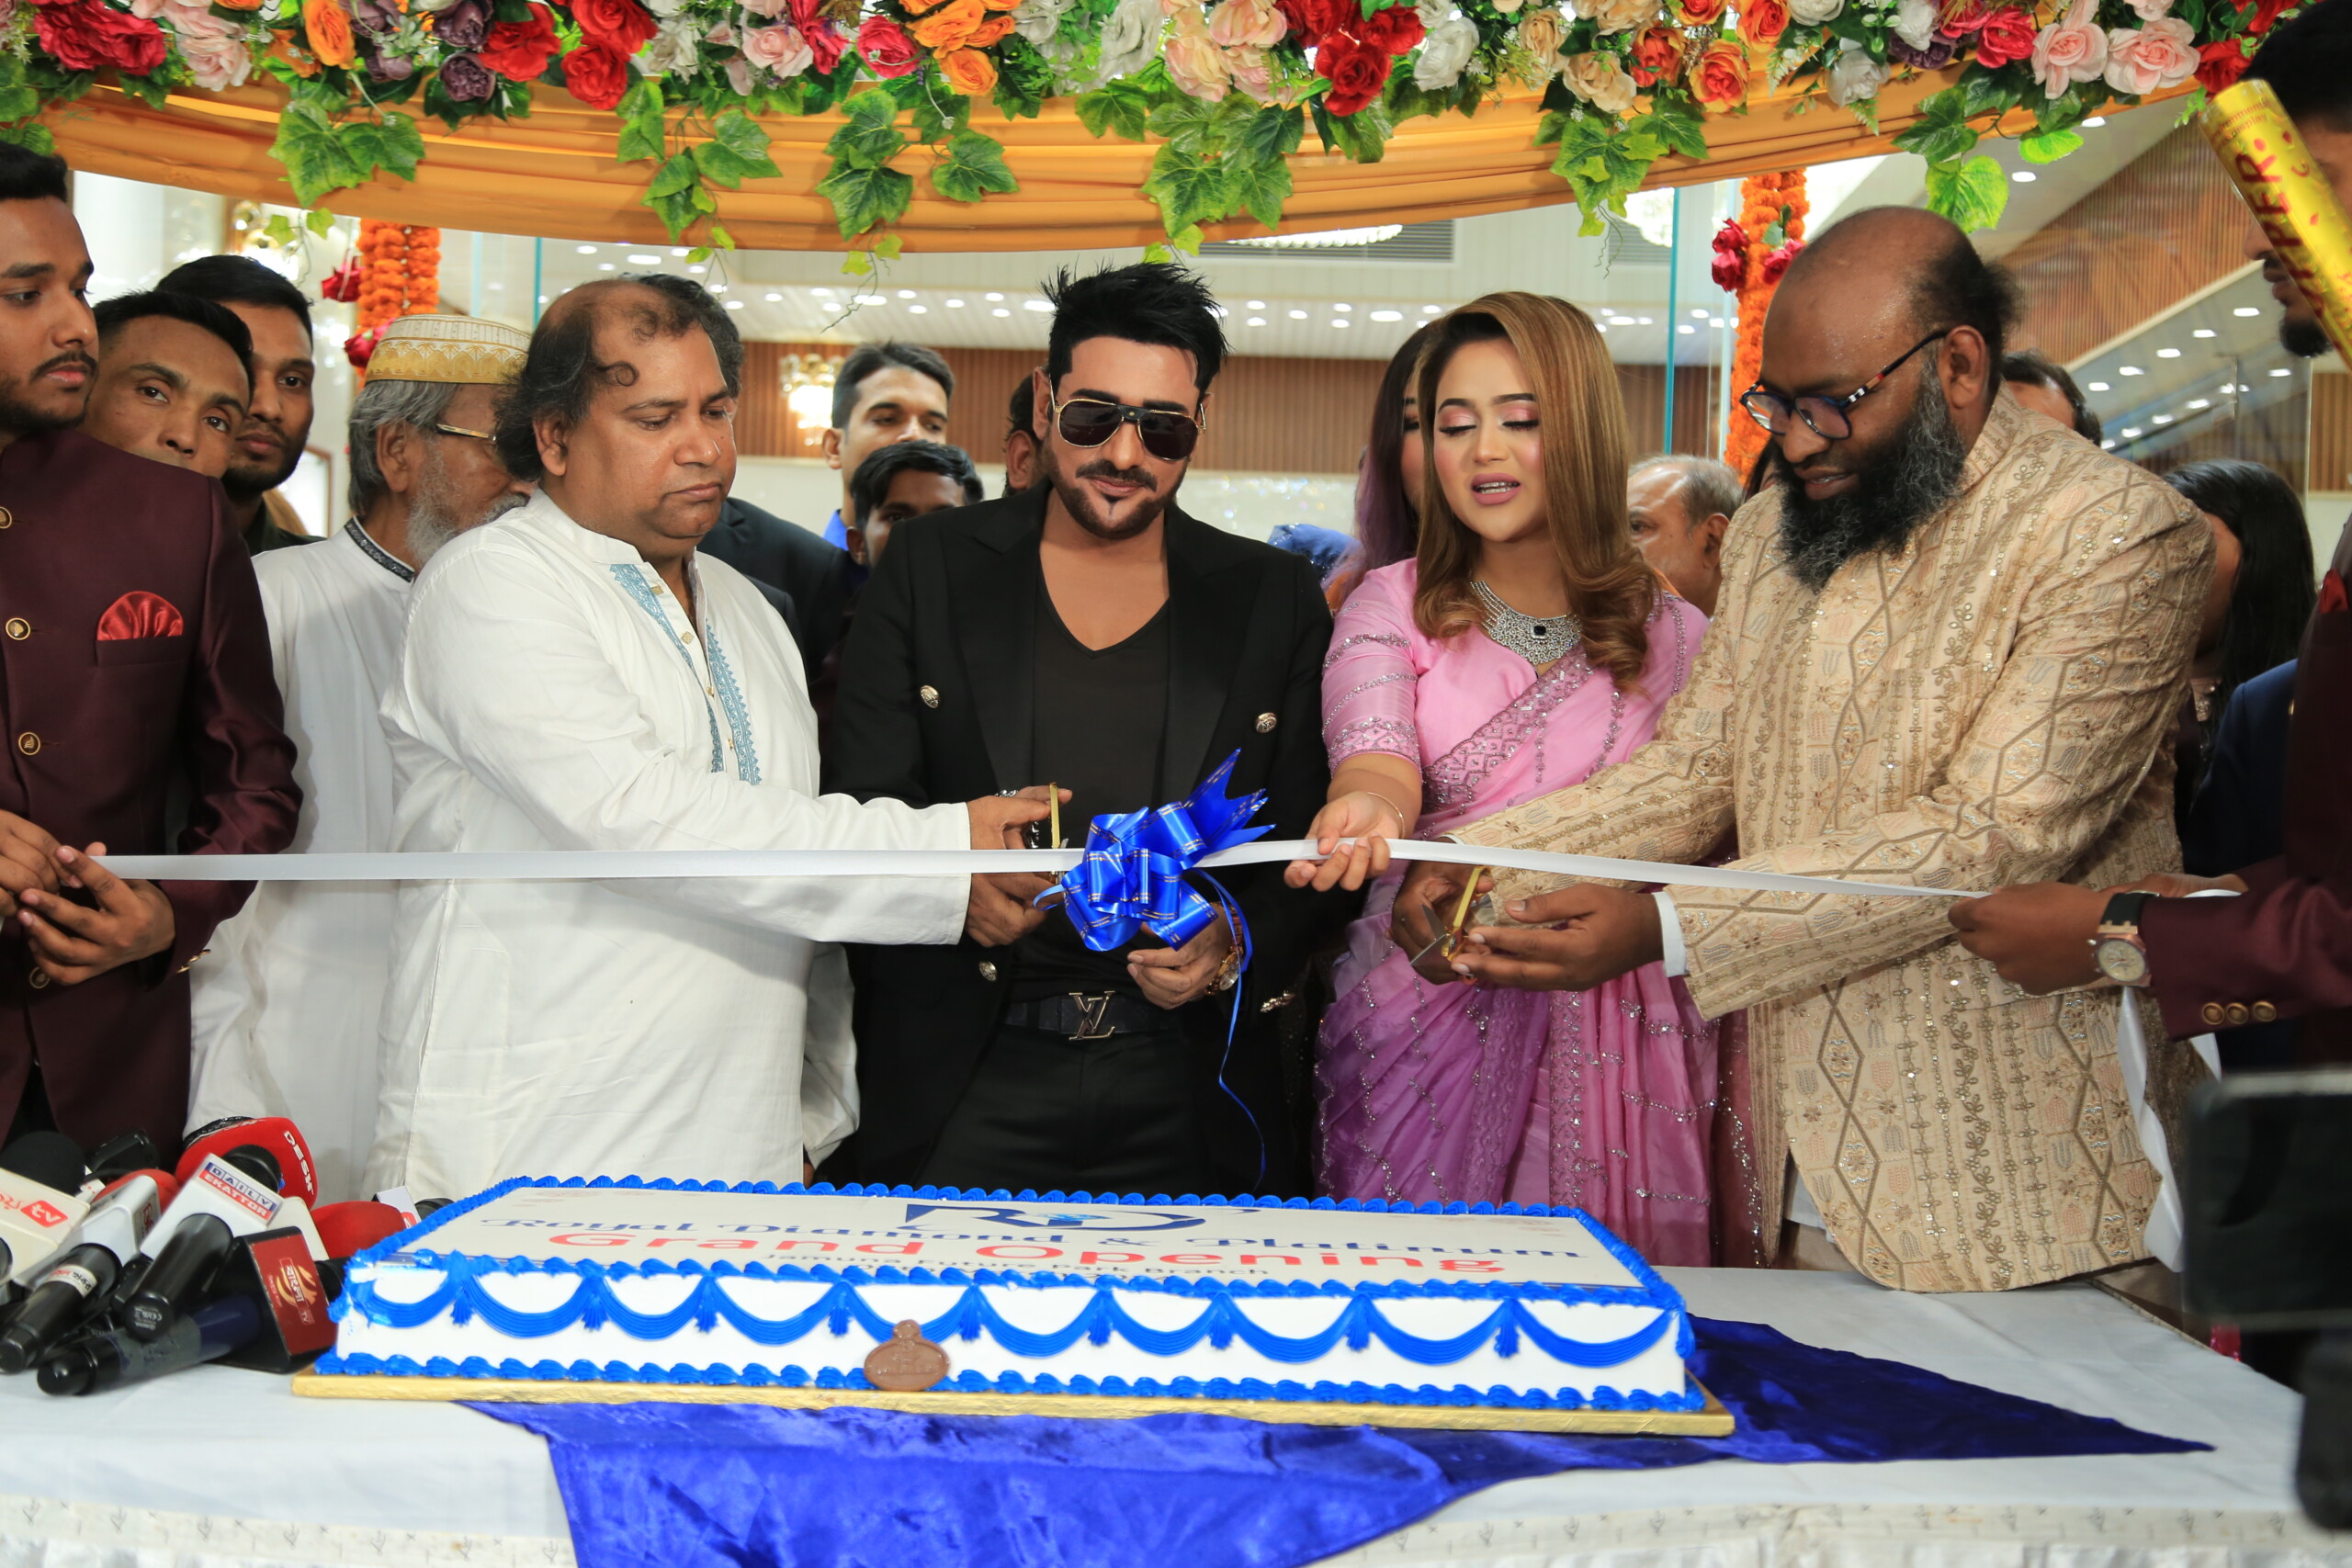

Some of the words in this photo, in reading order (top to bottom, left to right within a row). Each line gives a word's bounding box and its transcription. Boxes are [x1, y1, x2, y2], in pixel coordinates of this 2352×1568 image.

[283, 1131, 314, 1195] DESH
[204, 1173, 268, 1218] EKATTOR
[210, 1164, 273, 1209] DAILY
[481, 1219, 698, 1232] Royal
[718, 1224, 1070, 1243] Diamond
[1098, 1238, 1159, 1247] &
[1185, 1238, 1588, 1258] Platinum
[548, 1233, 924, 1255] Grand
[976, 1245, 1506, 1273] Opening
[763, 1254, 902, 1264] Jamuna
[919, 1259, 1036, 1269] Future
[1052, 1264, 1131, 1273] Park
